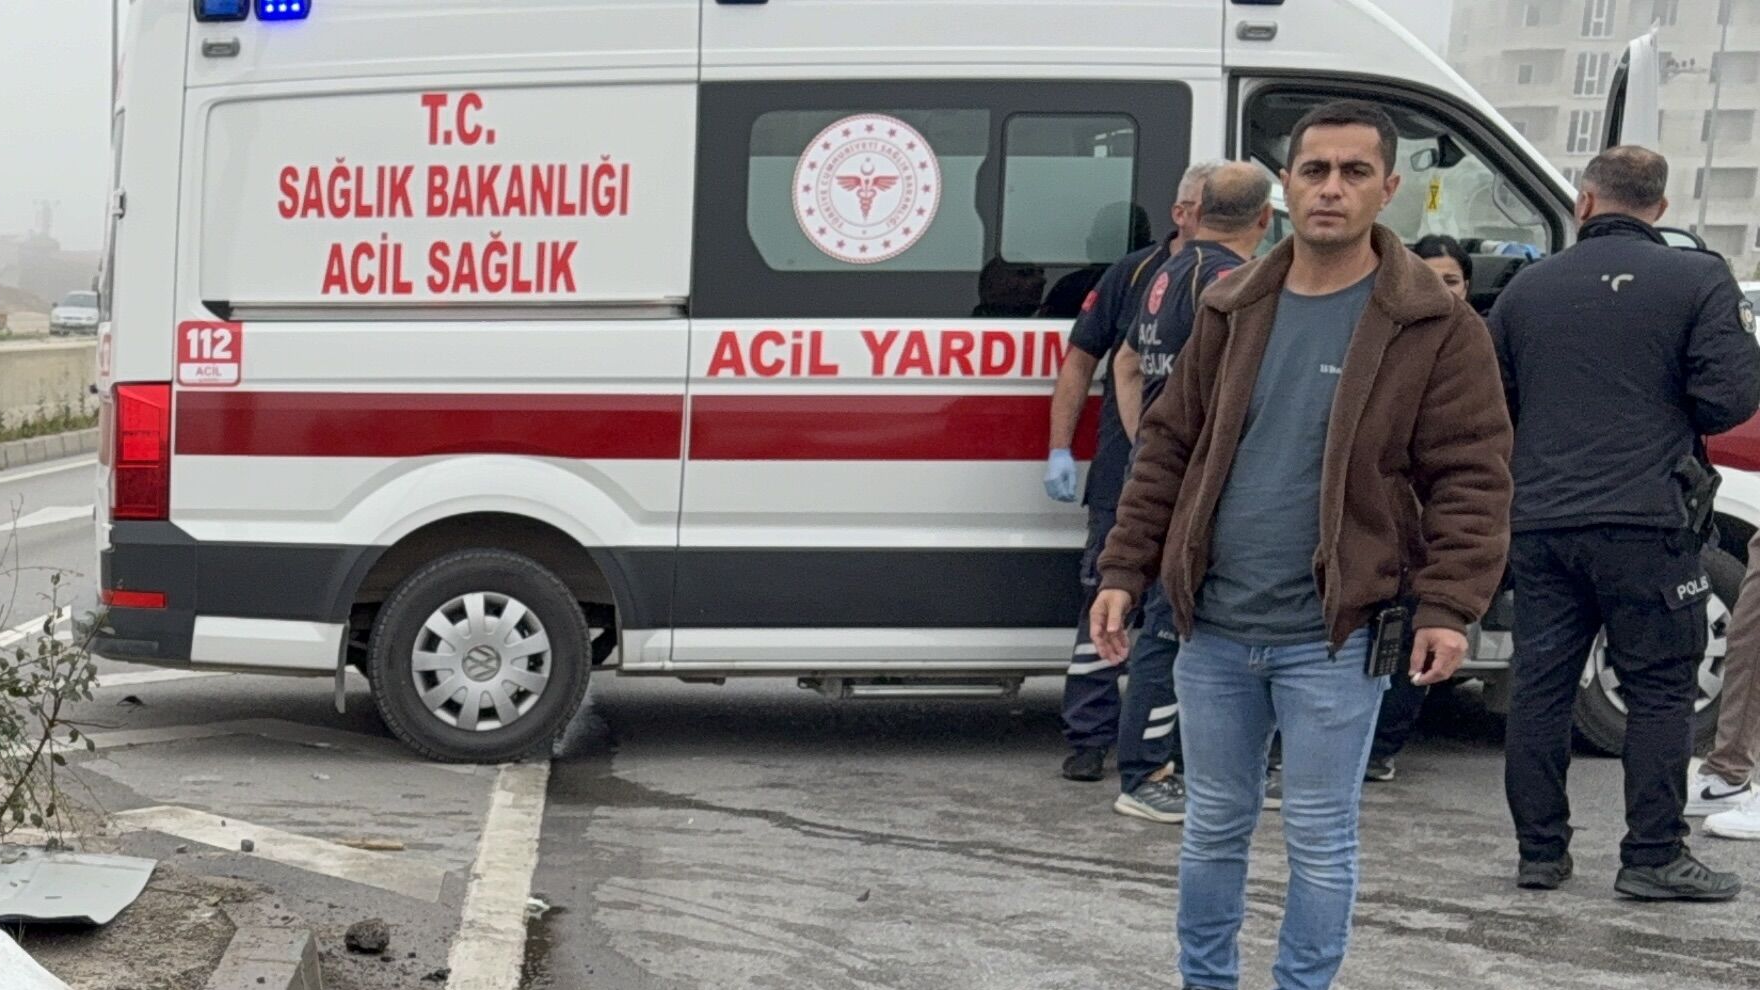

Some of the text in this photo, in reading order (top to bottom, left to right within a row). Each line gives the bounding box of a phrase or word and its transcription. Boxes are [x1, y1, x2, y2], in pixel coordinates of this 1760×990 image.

[421, 92, 496, 145] T.C.
[278, 154, 630, 218] SAĞLIK BAKANLIĞI
[321, 230, 578, 294] ACİL SAĞLIK
[186, 328, 233, 359] 112
